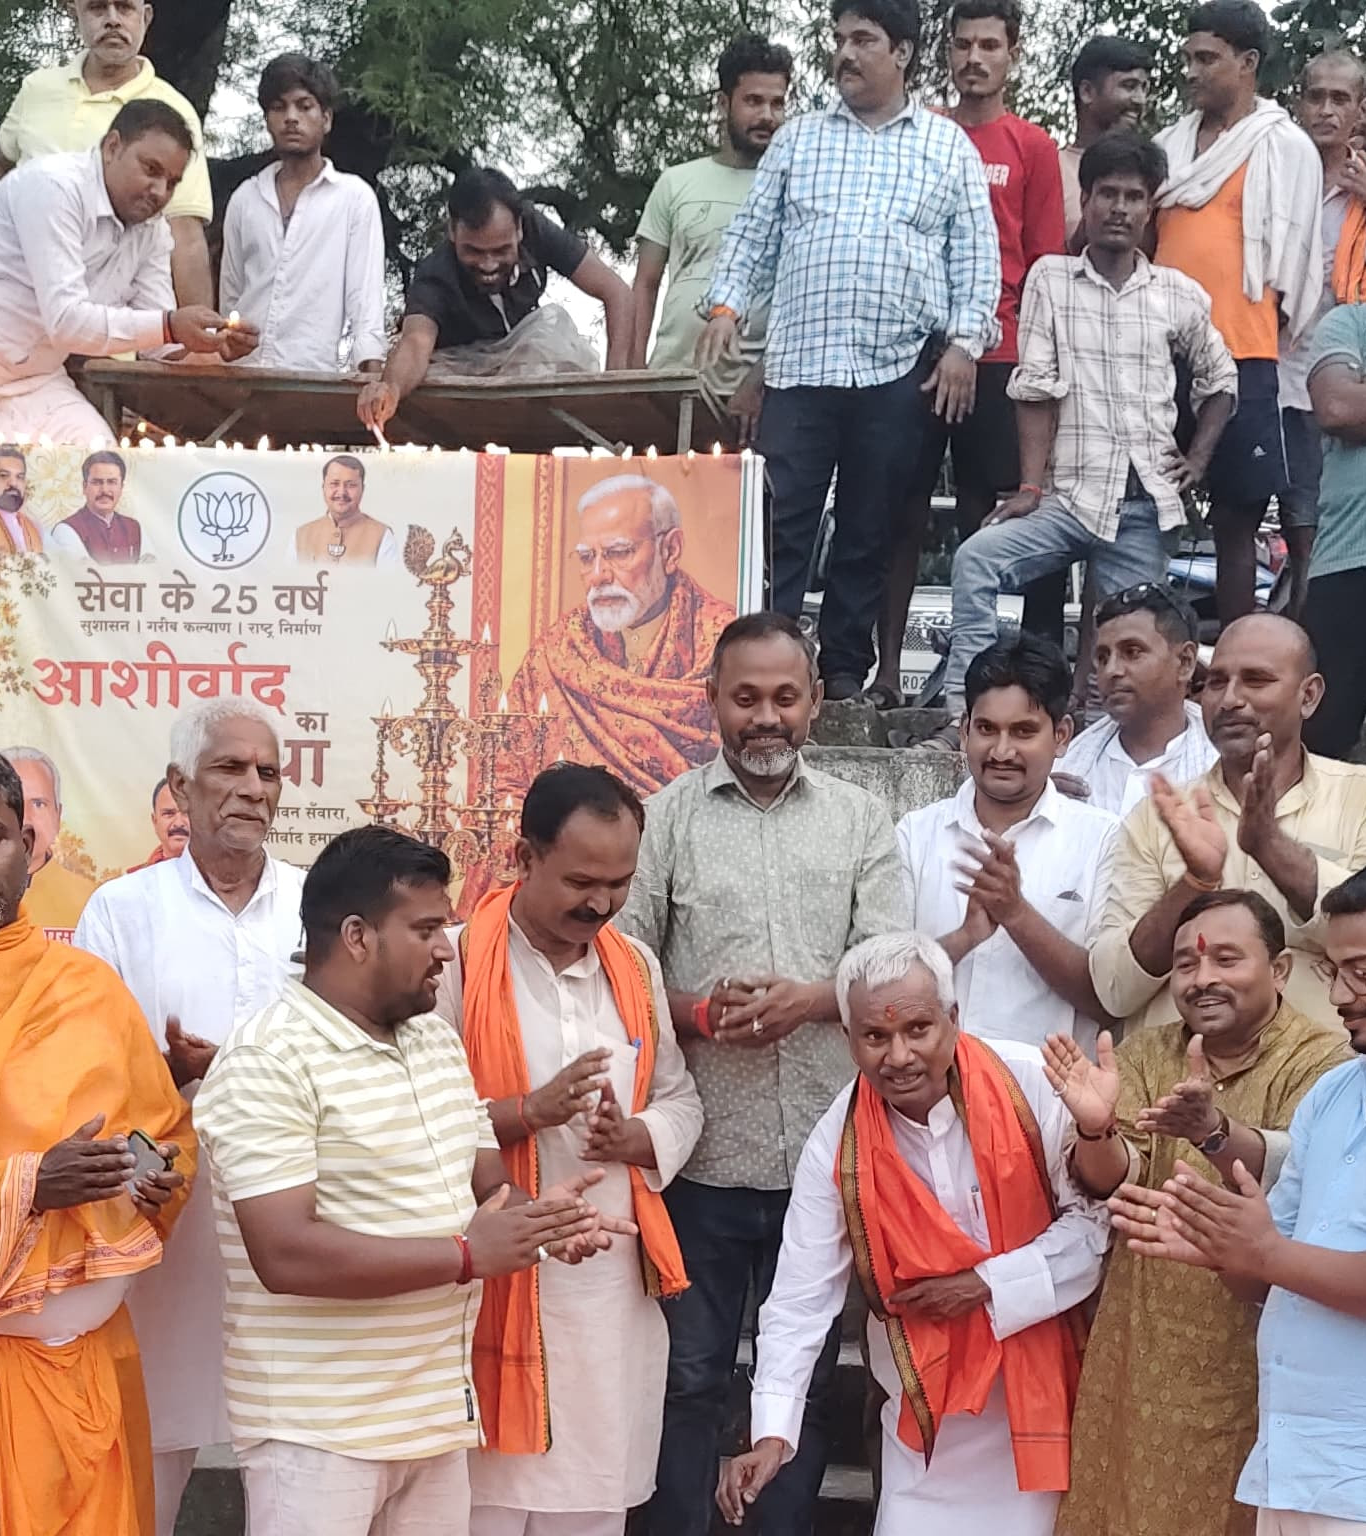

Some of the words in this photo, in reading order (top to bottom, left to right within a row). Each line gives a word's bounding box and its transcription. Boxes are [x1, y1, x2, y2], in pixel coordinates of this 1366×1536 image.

[75, 568, 146, 612] सेवा
[159, 569, 196, 613] के
[211, 583, 258, 614] 25
[272, 570, 329, 616] वर्ष
[80, 619, 130, 637] सुशासन
[146, 617, 178, 633] गरीब
[183, 621, 231, 635] कल्याण
[279, 619, 322, 636] निर्माण
[33, 641, 291, 716] आशीर्वाद
[902, 675, 927, 690] R02
[295, 712, 329, 733] का
